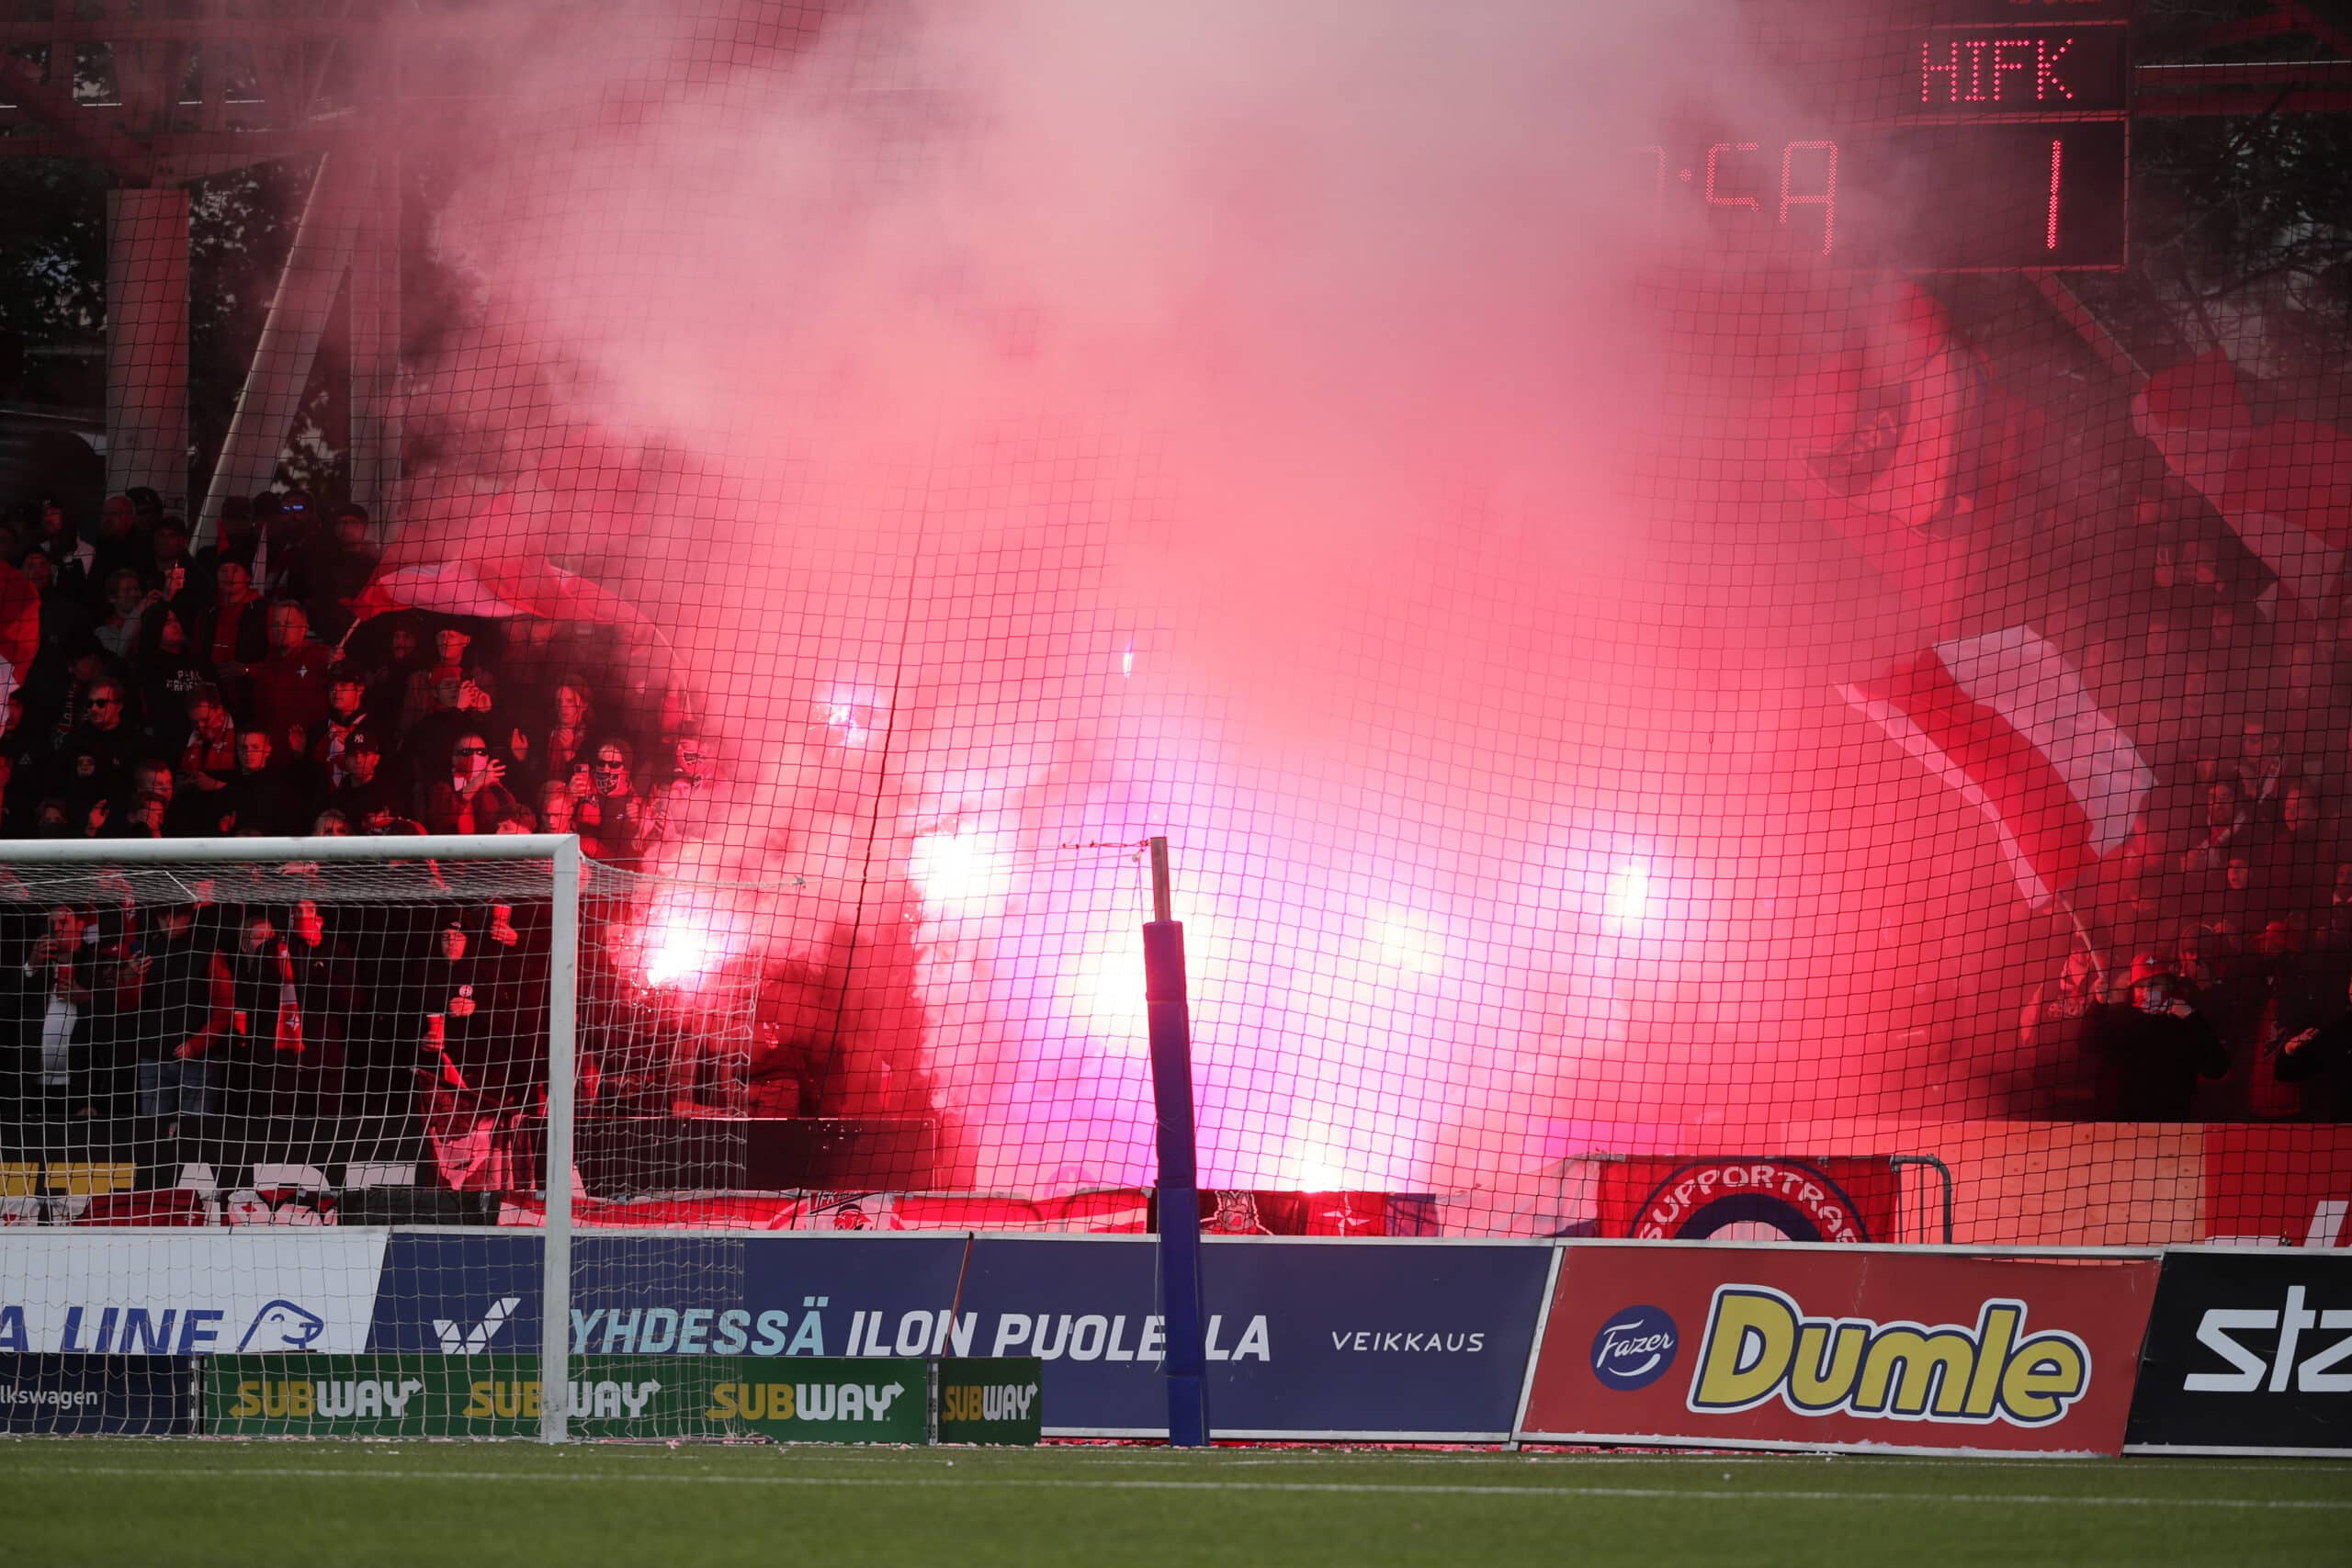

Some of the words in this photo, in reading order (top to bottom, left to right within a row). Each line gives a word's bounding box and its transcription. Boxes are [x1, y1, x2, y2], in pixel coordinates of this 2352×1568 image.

[1922, 39, 2073, 102] HIFK
[2047, 140, 2061, 249] 1
[59, 1306, 224, 1355] LINE
[570, 1296, 829, 1356] YHDESSÄ
[845, 1310, 978, 1357] ILON
[991, 1314, 1271, 1361] PUOLELA
[1331, 1331, 1485, 1352] VEIKKAUS
[1596, 1319, 1674, 1369] Fazer
[1687, 1283, 2092, 1428] Dumle
[229, 1378, 423, 1417] SUBWAY
[706, 1381, 905, 1421] SUBWAY
[943, 1381, 1038, 1422] SUBWAY
